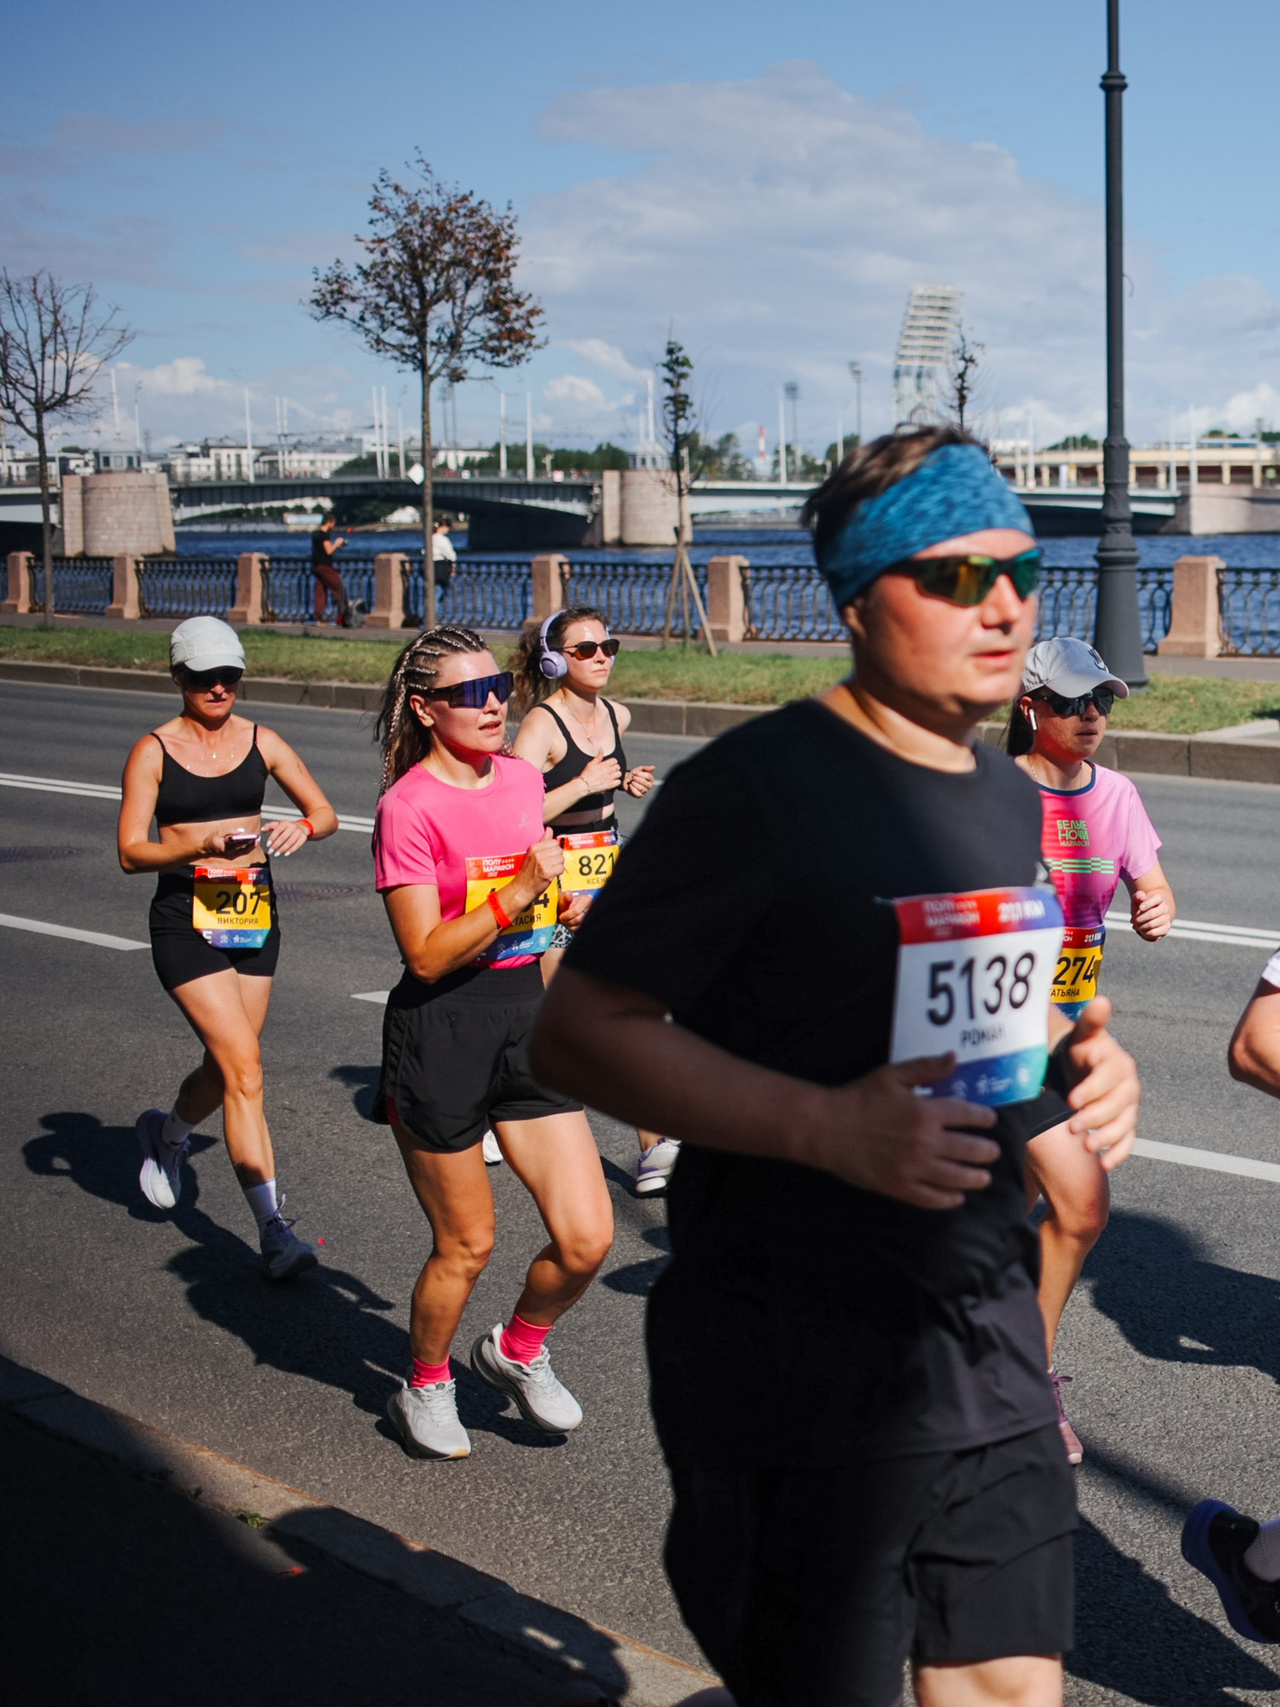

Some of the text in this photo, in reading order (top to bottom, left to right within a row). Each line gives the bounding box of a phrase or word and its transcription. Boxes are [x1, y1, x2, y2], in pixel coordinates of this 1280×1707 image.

[1056, 819, 1088, 830] БЕЛЫЕ
[1058, 829, 1089, 840] НОЧИ
[1059, 839, 1091, 847] МАРАФОН
[482, 858, 502, 866] ПОЛУ
[578, 852, 616, 876] 821
[482, 864, 515, 873] МАРАФОН
[216, 890, 260, 915] 207
[217, 917, 259, 925] ВИКТОРИЯ
[927, 951, 1035, 1027] 5138
[1050, 988, 1080, 997] АТЬЯНА
